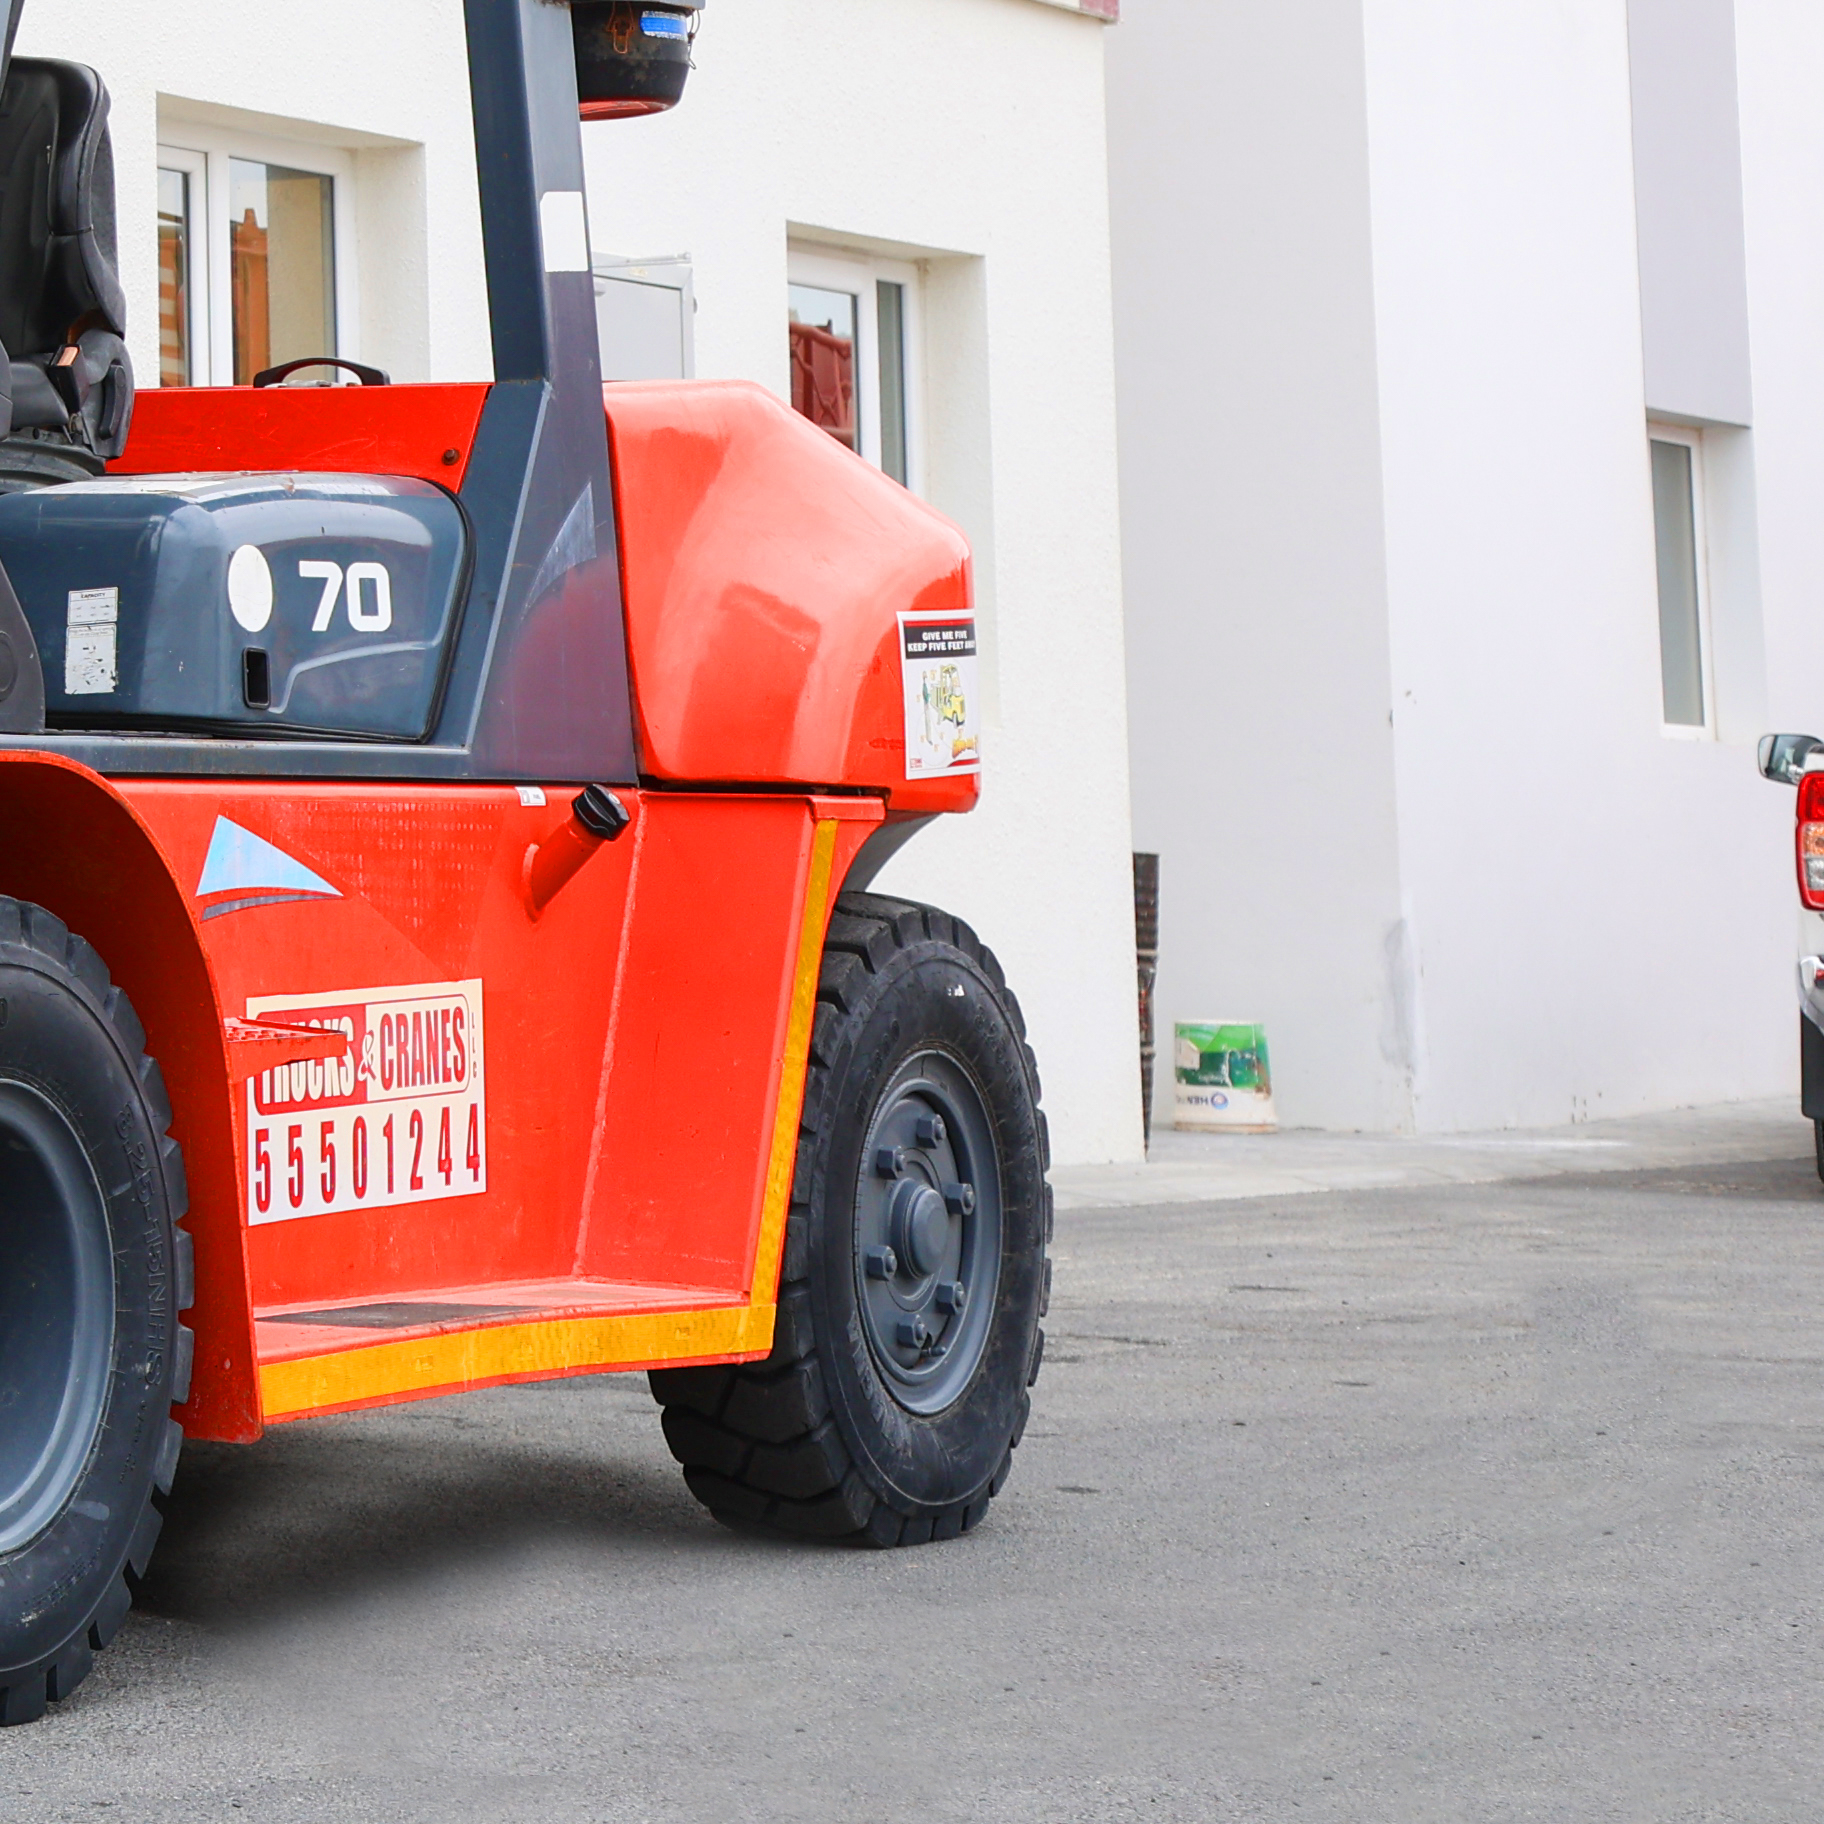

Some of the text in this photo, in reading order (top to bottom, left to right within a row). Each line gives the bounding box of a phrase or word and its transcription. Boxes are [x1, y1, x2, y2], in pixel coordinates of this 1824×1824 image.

[298, 560, 393, 633] 70
[907, 642, 928, 652] KEEP
[928, 642, 947, 651] FIVE
[921, 630, 968, 641] GIVE ME FIVE
[357, 1030, 377, 1082] &
[379, 1005, 467, 1092] CRANES
